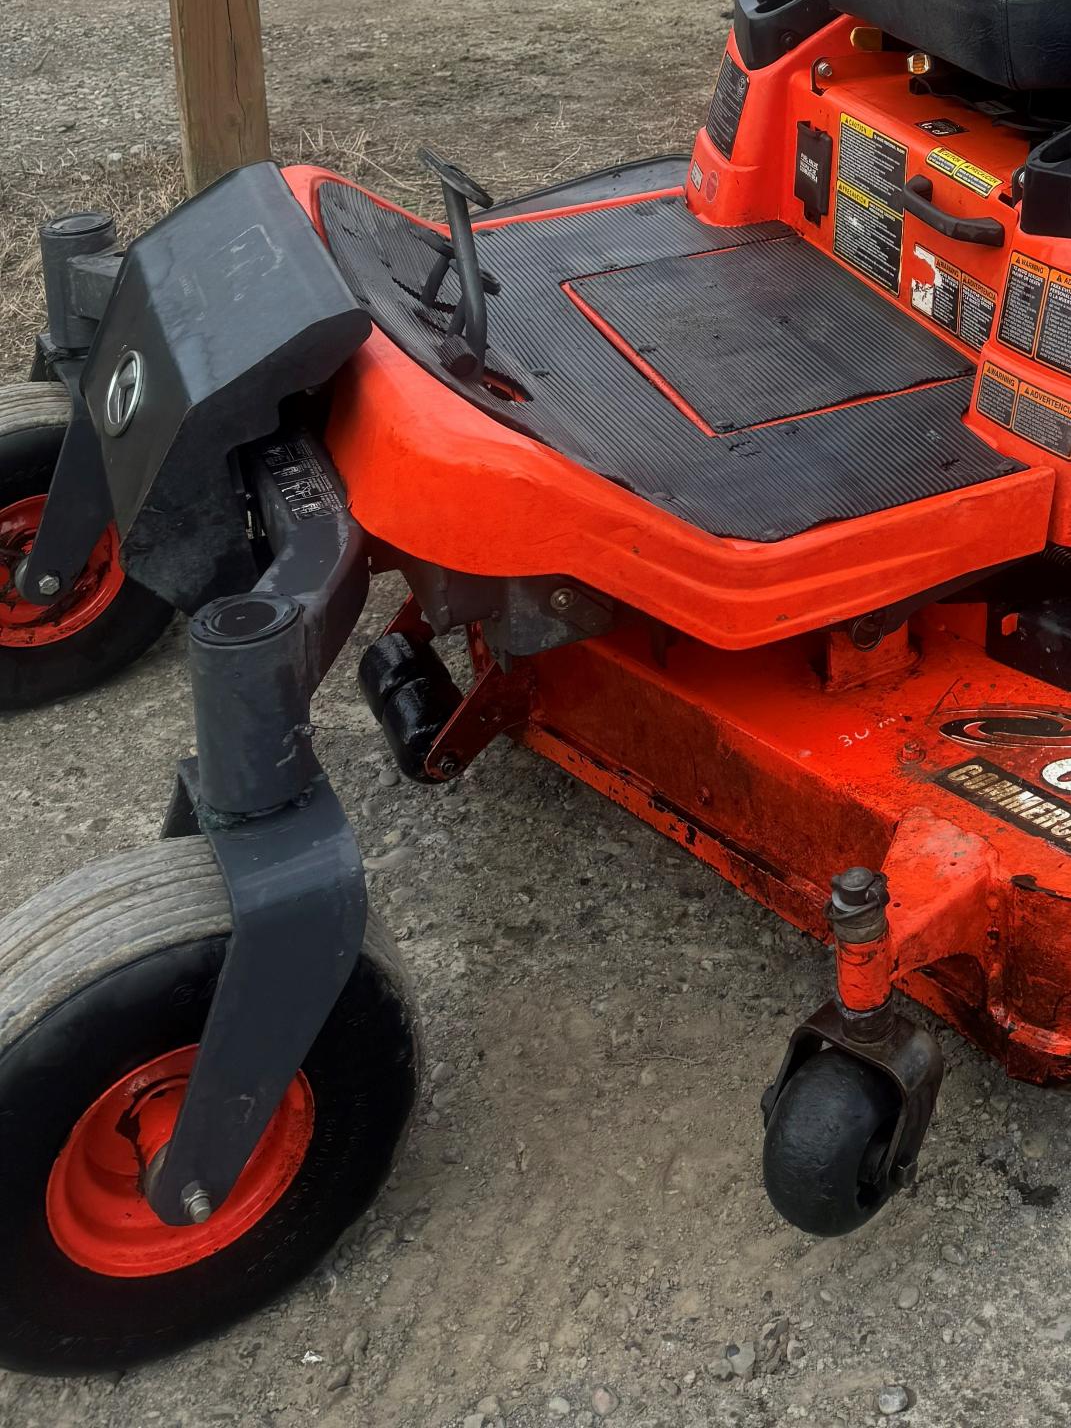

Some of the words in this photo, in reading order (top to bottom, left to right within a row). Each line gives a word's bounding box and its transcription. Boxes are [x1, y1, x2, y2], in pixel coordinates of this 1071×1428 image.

[848, 118, 867, 134] CAUTION
[941, 151, 960, 163] CAUTION
[1021, 259, 1043, 274] WARNING
[991, 369, 1014, 387] WARNING
